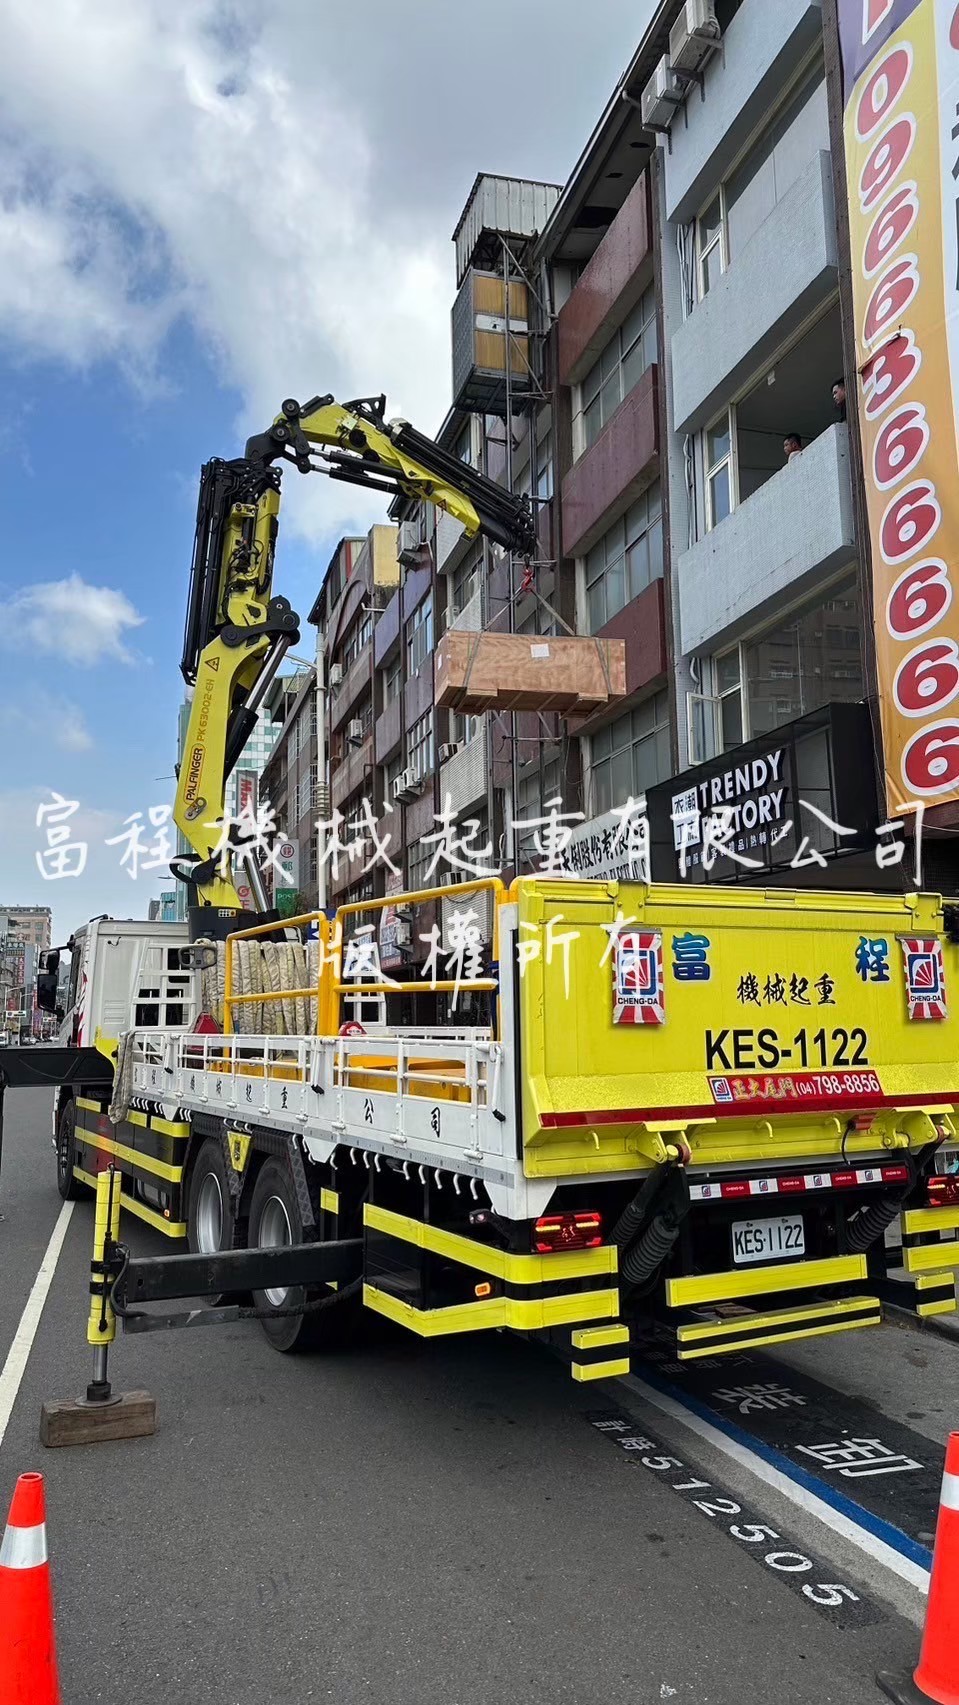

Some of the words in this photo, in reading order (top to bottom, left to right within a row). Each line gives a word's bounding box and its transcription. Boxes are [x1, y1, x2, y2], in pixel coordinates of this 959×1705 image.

[186, 747, 203, 801] PALFINGER
[197, 729, 206, 743] PK
[700, 750, 781, 808] TRENDY
[701, 788, 783, 846] FATORY
[671, 932, 711, 981] 富
[855, 935, 890, 982] 程
[617, 997, 659, 1005] CHENG-DA
[737, 972, 838, 1007] 機械起重
[705, 1028, 868, 1070] KES-1122
